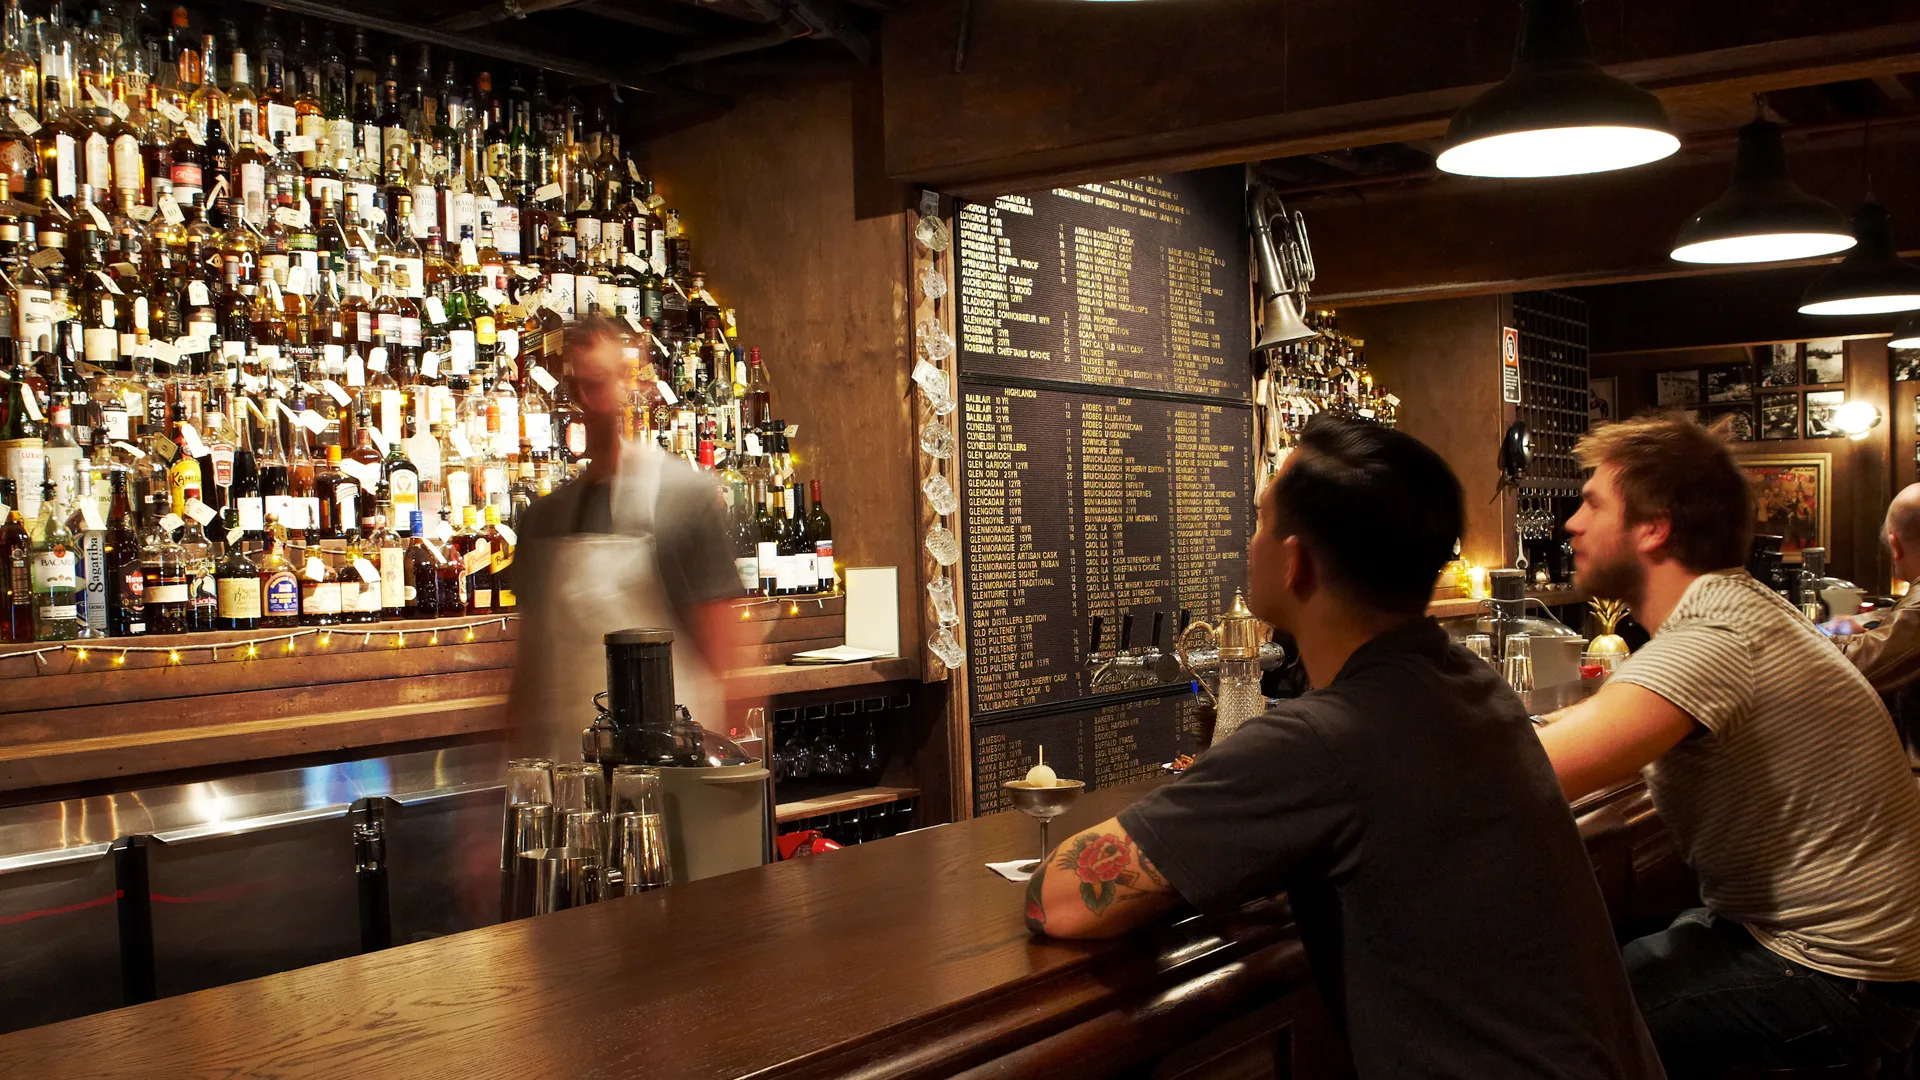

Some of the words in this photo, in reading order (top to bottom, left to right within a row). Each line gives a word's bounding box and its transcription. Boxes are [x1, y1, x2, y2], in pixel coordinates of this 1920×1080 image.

[1134, 182, 1144, 192] ALE
[1102, 186, 1128, 200] AMERICAN
[1148, 197, 1156, 208] ALE
[1096, 197, 1120, 210] ESPRESSO
[960, 211, 988, 224] LONGROW
[961, 230, 996, 244] SPRINGBANK
[1108, 226, 1130, 237] ISLANDS
[961, 248, 997, 263] SPRINGBANK
[999, 255, 1020, 267] BARREL
[1021, 259, 1039, 270] PROOF
[962, 258, 997, 272] SPRINGBANK
[998, 264, 1008, 274] CV
[962, 267, 1007, 283] AUCHENTOSHAN
[1009, 276, 1033, 287] CLASSIC
[962, 277, 1008, 292] AUCHENTOSHAN
[1014, 285, 1032, 296] WOOD
[962, 286, 1008, 301] AUCHENTOSHAN
[963, 305, 995, 317] BLADNOCH
[998, 310, 1037, 323] CONNOISSEUR
[1078, 313, 1092, 322] JURA
[1094, 315, 1119, 326] PROPHECY
[964, 314, 1002, 328] GLENKINCHIE
[964, 324, 993, 336] ROSEBANK
[1079, 322, 1092, 331] JURA
[1094, 324, 1129, 336] SUPERSTITION
[964, 334, 994, 345] ROSEBANK
[964, 343, 994, 354] ROSEBANK
[1030, 350, 1051, 360] CHOICE
[1080, 348, 1104, 358] TALISKER
[965, 394, 991, 404] BALBLAIR
[1005, 388, 1037, 398] HIGHLANDS
[966, 404, 992, 413] BALBLAIR
[106, 416, 118, 424] Lg
[1082, 412, 1102, 420] ARDBEG
[966, 423, 995, 432] CLYNELISH
[967, 442, 996, 450] CLYNELISH
[998, 443, 1027, 451] DISTILLERS
[967, 451, 982, 459] GLEN
[970, 535, 1015, 543] GLENMORANGIE
[970, 544, 1016, 552] GLENMORANGIE
[971, 553, 1016, 562] GLENMORANGIE
[88, 538, 104, 593] Sagatiba
[971, 562, 1016, 571] GLENMORANGIE
[971, 572, 1016, 581] GLENMORANGIE
[972, 581, 1017, 590] GLENMORANGIE
[1019, 579, 1054, 587] TRADITIONAL
[972, 590, 1009, 600] GLENTURRET
[1088, 592, 1115, 600] LAGAVULIN
[1132, 588, 1155, 596] STRENGTH
[973, 599, 1009, 609] INCHMURRIN
[992, 616, 1023, 626] DISTILLERS
[1026, 614, 1047, 623] EDITION
[974, 629, 986, 637] OLD
[988, 626, 1017, 635] PULTENEY
[1020, 624, 1033, 632] 12YR
[974, 638, 986, 646] OLD
[989, 635, 1017, 645] PULTENEY
[975, 657, 987, 665] OLD
[990, 653, 1018, 663] PULTENEY
[1021, 651, 1034, 659] 21YR
[976, 666, 988, 675] OLD
[990, 663, 1016, 672] PULTENE
[977, 674, 1002, 683] TOMATIN
[1006, 671, 1019, 679] 18YR
[977, 683, 1002, 693] TOMATIN
[1004, 679, 1030, 689] OLOROSO
[1032, 676, 1052, 685] SHERRY
[1054, 674, 1068, 682] CASK
[978, 692, 1003, 702] TOMATIN
[1005, 689, 1024, 698] SINGLE
[1026, 686, 1041, 695] CASK
[978, 699, 1018, 712] TULLIBARDINE
[1023, 696, 1036, 705] 20YR
[979, 734, 1006, 746] JAMESON
[1095, 740, 1116, 750] BUFFALO
